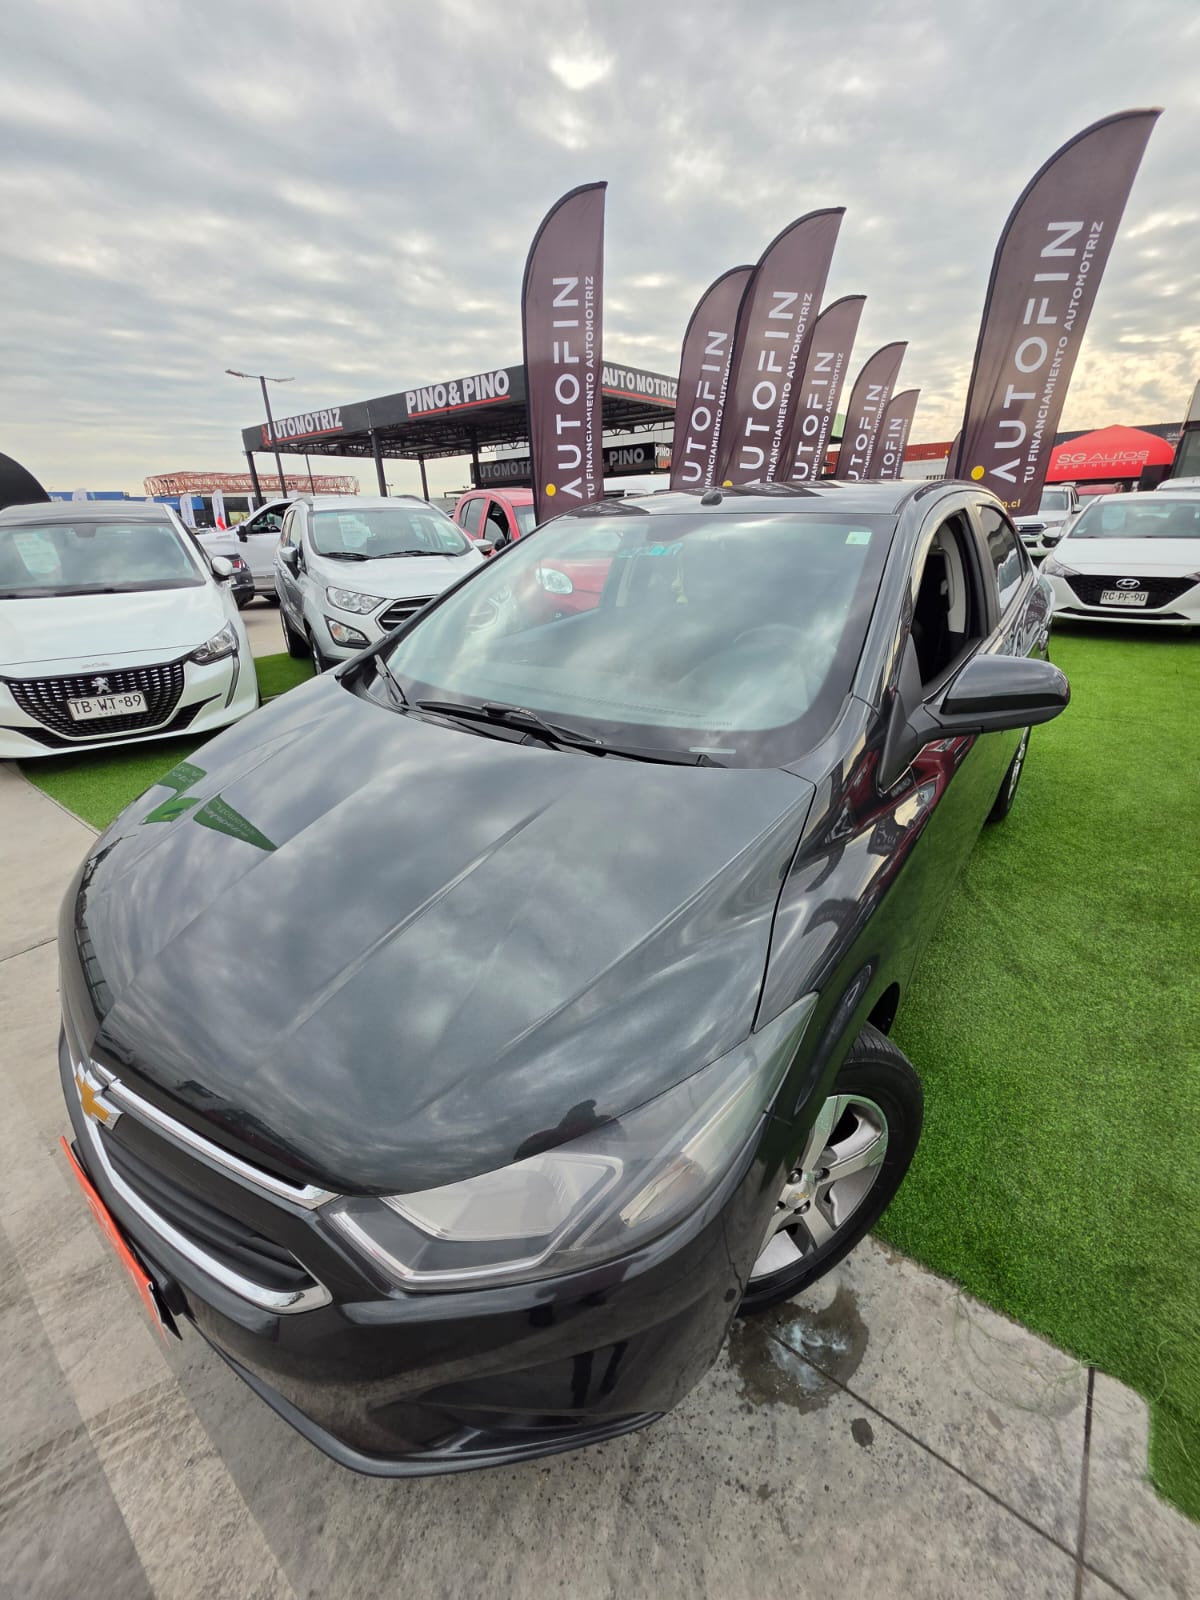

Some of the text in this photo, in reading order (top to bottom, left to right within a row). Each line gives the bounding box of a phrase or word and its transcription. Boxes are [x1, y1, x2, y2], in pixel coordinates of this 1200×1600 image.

[553, 277, 583, 499] AUTOFIN
[585, 276, 596, 499] TU FINANCIAMIENTO AUTOMOTRIZ
[602, 366, 678, 399] AUTOMOTRIZ
[682, 331, 728, 482] UTOFIN
[766, 292, 813, 482] FINANCIAMIENTO AUTOMOTRIZ
[792, 352, 835, 480] UTOFIN
[989, 221, 1083, 483] AUTOFIN
[1024, 221, 1104, 483] TU FINANCIAMIENTO AUTOMOTRIZ
[609, 447, 645, 466] PINO
[704, 409, 723, 488] INANCIAMIENTO
[810, 415, 830, 481] NANCIAMIENTO
[848, 385, 882, 480] UTOFIN
[881, 418, 903, 477] TOFIN
